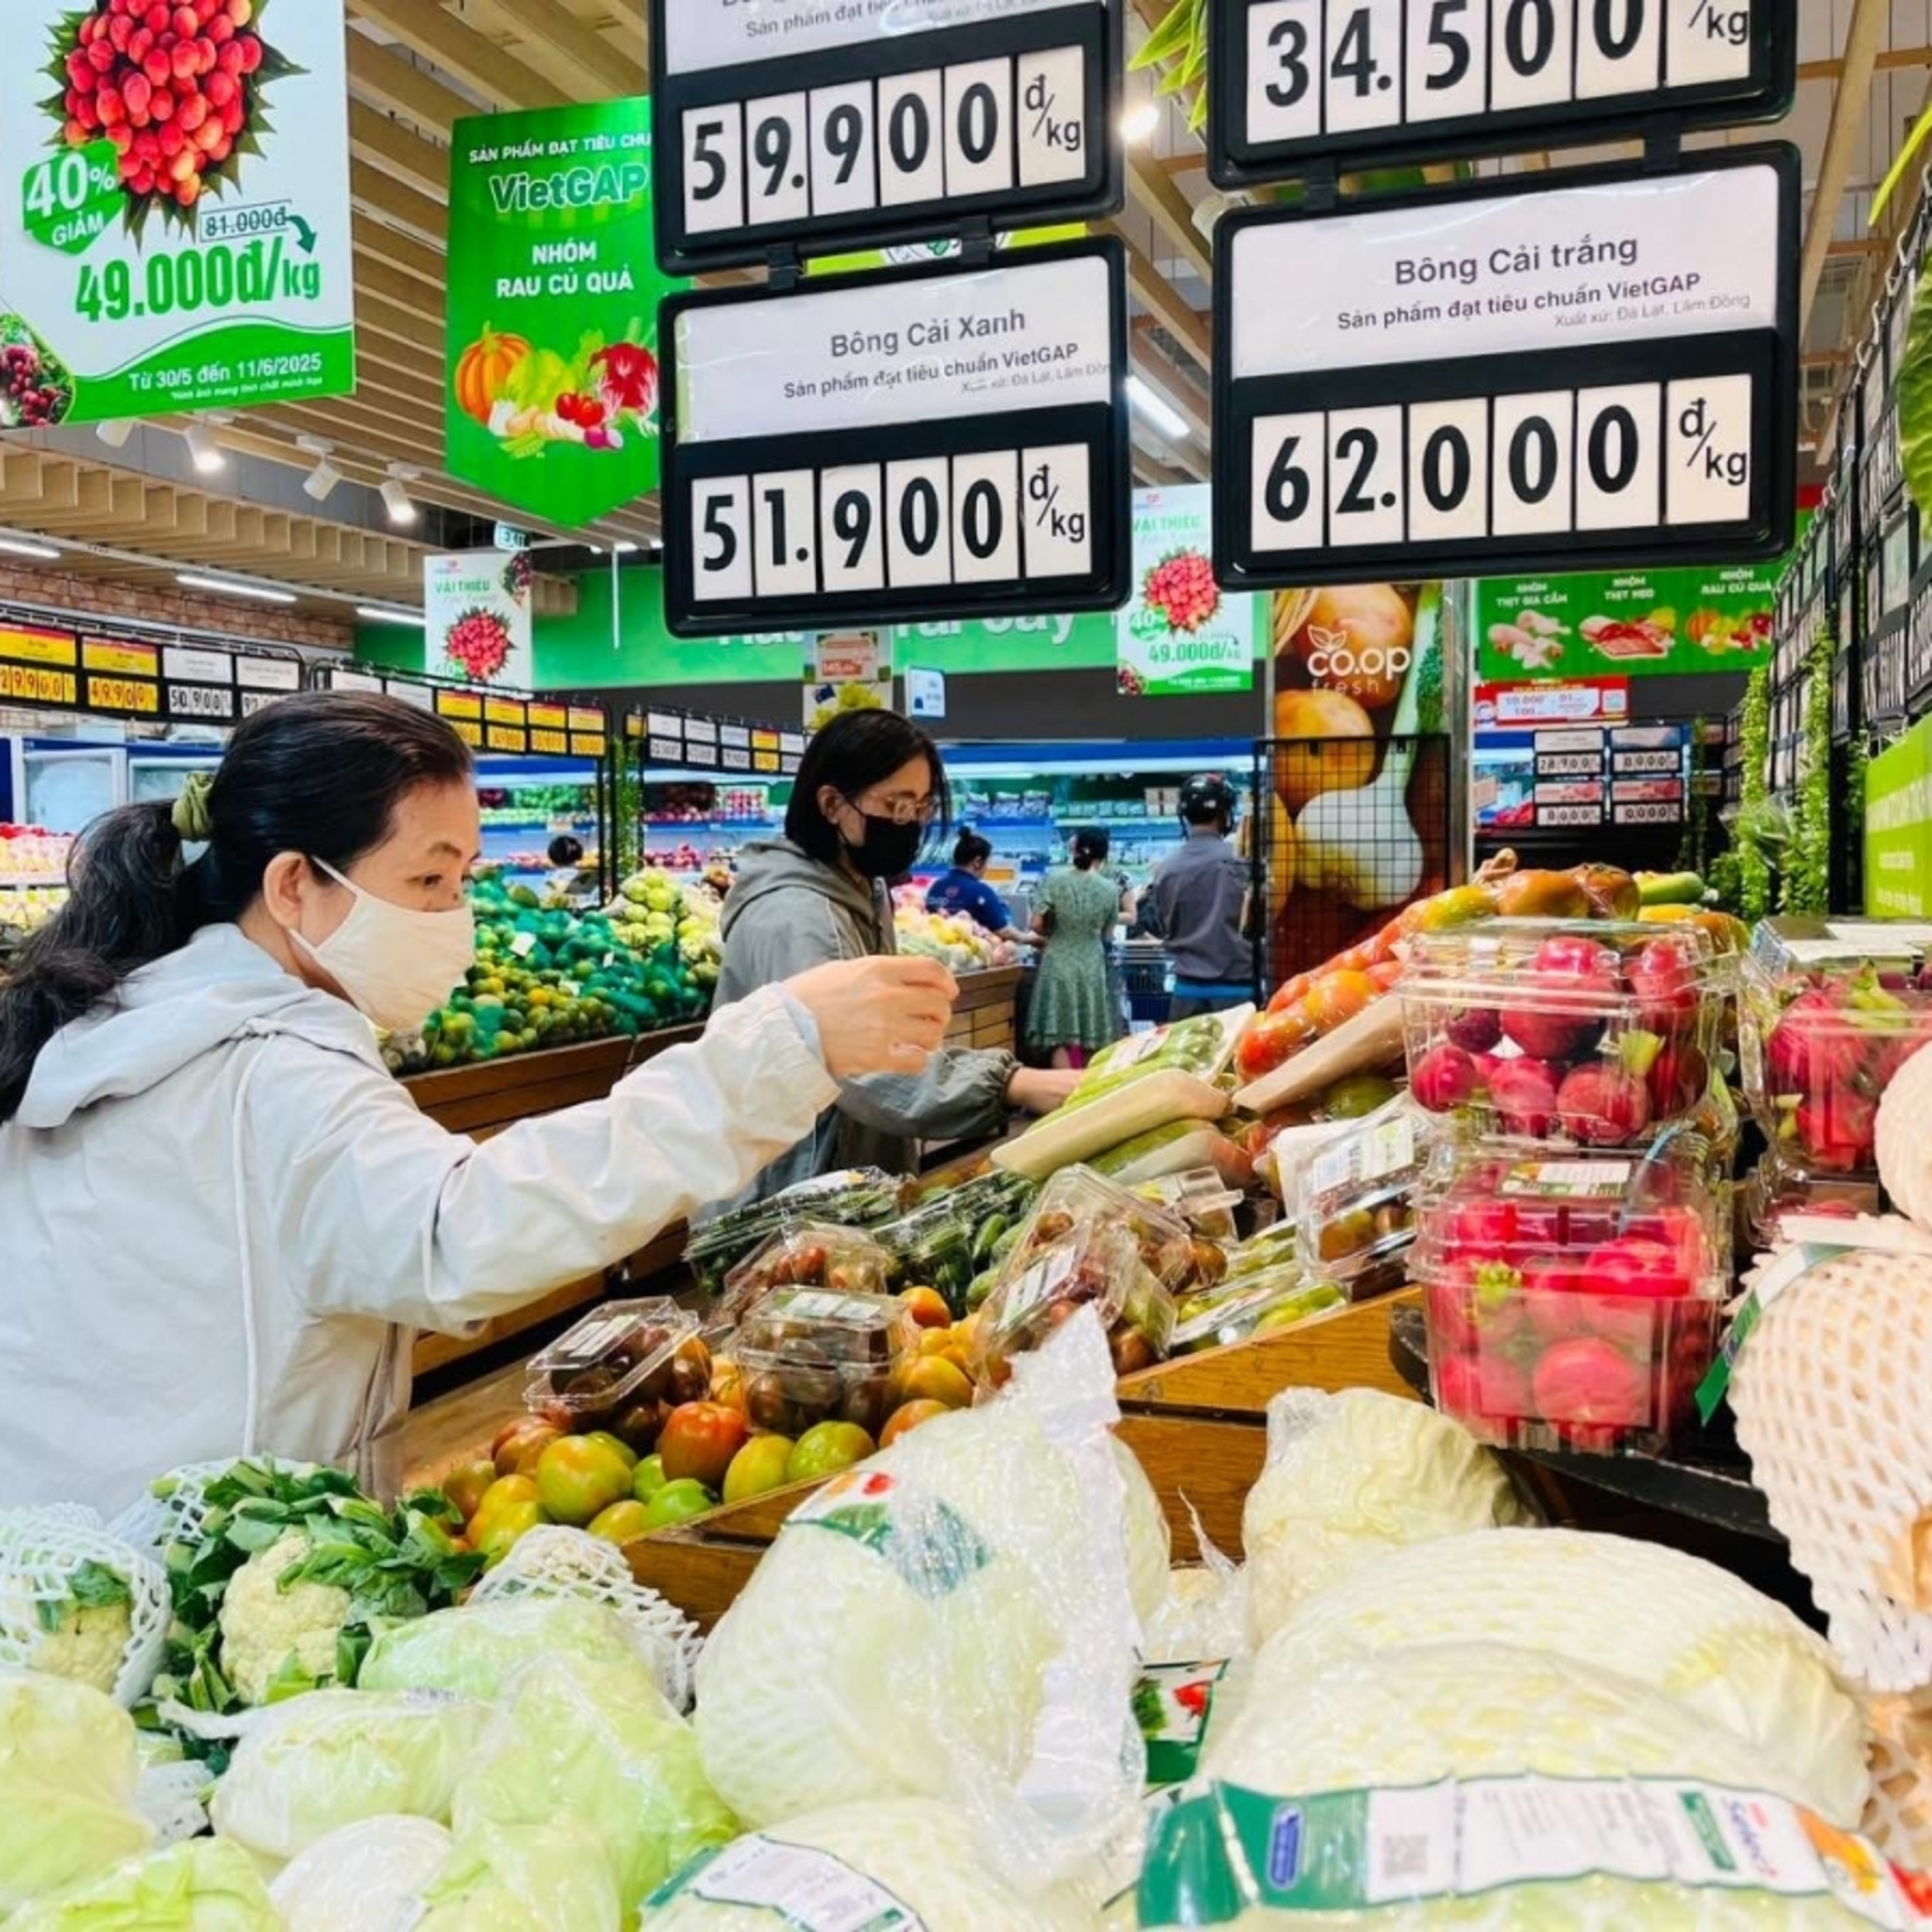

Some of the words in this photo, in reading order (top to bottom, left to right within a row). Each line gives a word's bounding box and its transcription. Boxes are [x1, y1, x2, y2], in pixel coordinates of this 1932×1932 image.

[1265, 0, 1643, 107] 34.500
[621, 132, 651, 149] CHU
[692, 82, 998, 200] 59.900
[1025, 73, 1081, 151] đ/kg
[26, 153, 115, 218] 40%
[489, 162, 648, 213] VietGAP
[52, 210, 104, 245] GIẢM
[205, 206, 287, 236] 81.000đ
[532, 238, 597, 265] NHÓM
[1396, 257, 1478, 287] Bông
[1489, 245, 1540, 275] Cải
[1552, 234, 1638, 269] trắng
[75, 235, 321, 323] 49.000đ/kg
[496, 277, 540, 298] RAU
[549, 267, 578, 294] CỦ
[586, 263, 634, 292] QUẢ
[1338, 308, 1377, 330] Sản
[1383, 302, 1441, 329] phẩm
[1448, 299, 1481, 321] đạt
[1488, 294, 1528, 314] tiêu
[1534, 282, 1601, 310] chuẩn
[1607, 272, 1701, 300] VietGAP
[831, 330, 899, 358] Bông
[907, 317, 949, 347] Cải
[958, 309, 1026, 340] Xanh
[156, 366, 192, 388] 30/5
[197, 360, 231, 383] đến
[237, 352, 322, 379] 11/6/2025
[784, 379, 817, 399] Sản
[1002, 343, 1079, 368] VietGAP
[1265, 404, 1639, 522] 62.000
[1679, 397, 1748, 486] đ/kg
[703, 477, 1003, 573] 51.900
[1029, 464, 1086, 543] đ/kg
[1307, 647, 1411, 681] co.op
[1312, 678, 1379, 696] fresh
